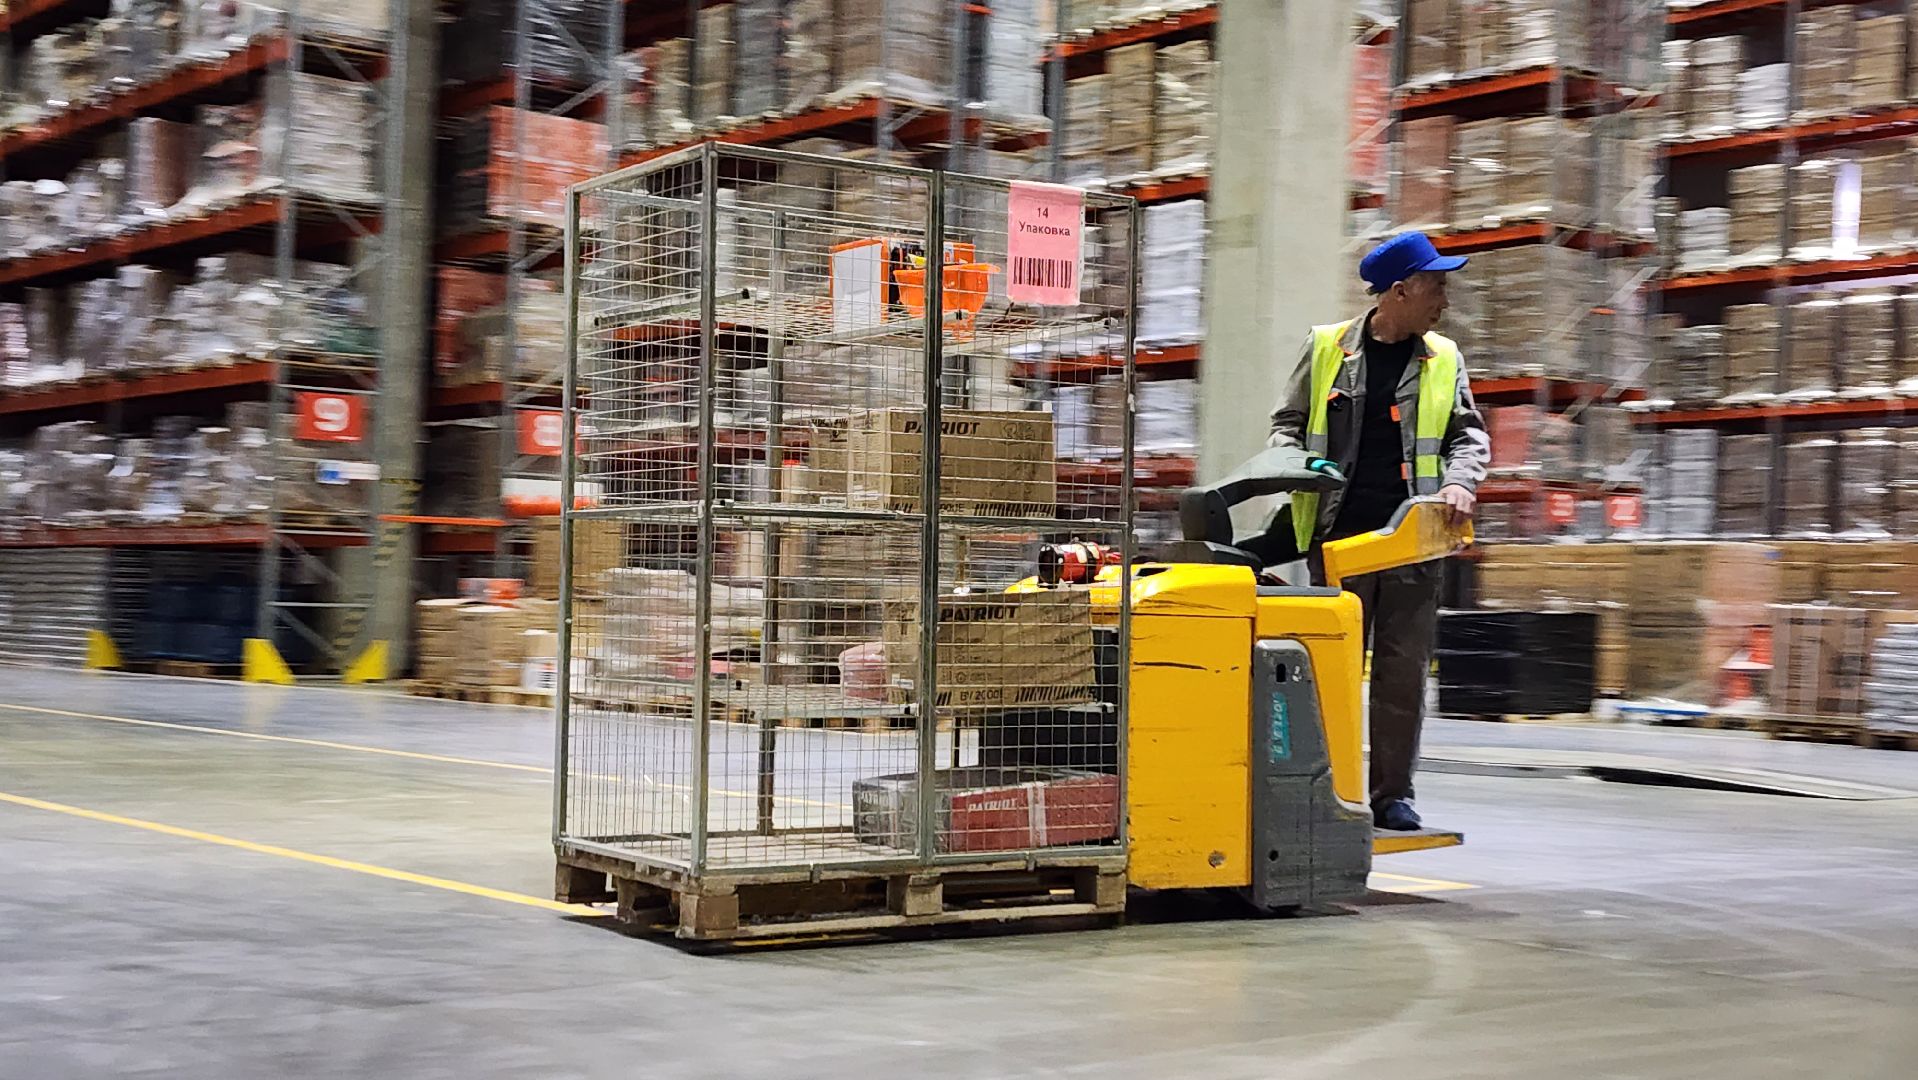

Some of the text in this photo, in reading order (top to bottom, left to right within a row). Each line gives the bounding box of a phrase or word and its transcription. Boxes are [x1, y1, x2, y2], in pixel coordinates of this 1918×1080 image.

[1037, 207, 1049, 218] 14
[1018, 221, 1071, 236] Упаковка
[313, 397, 349, 432] 9
[904, 421, 980, 434] PRIOT
[1611, 498, 1637, 521] 2
[940, 606, 1019, 622] PATRIOT
[968, 798, 1018, 812] PATRIOT
